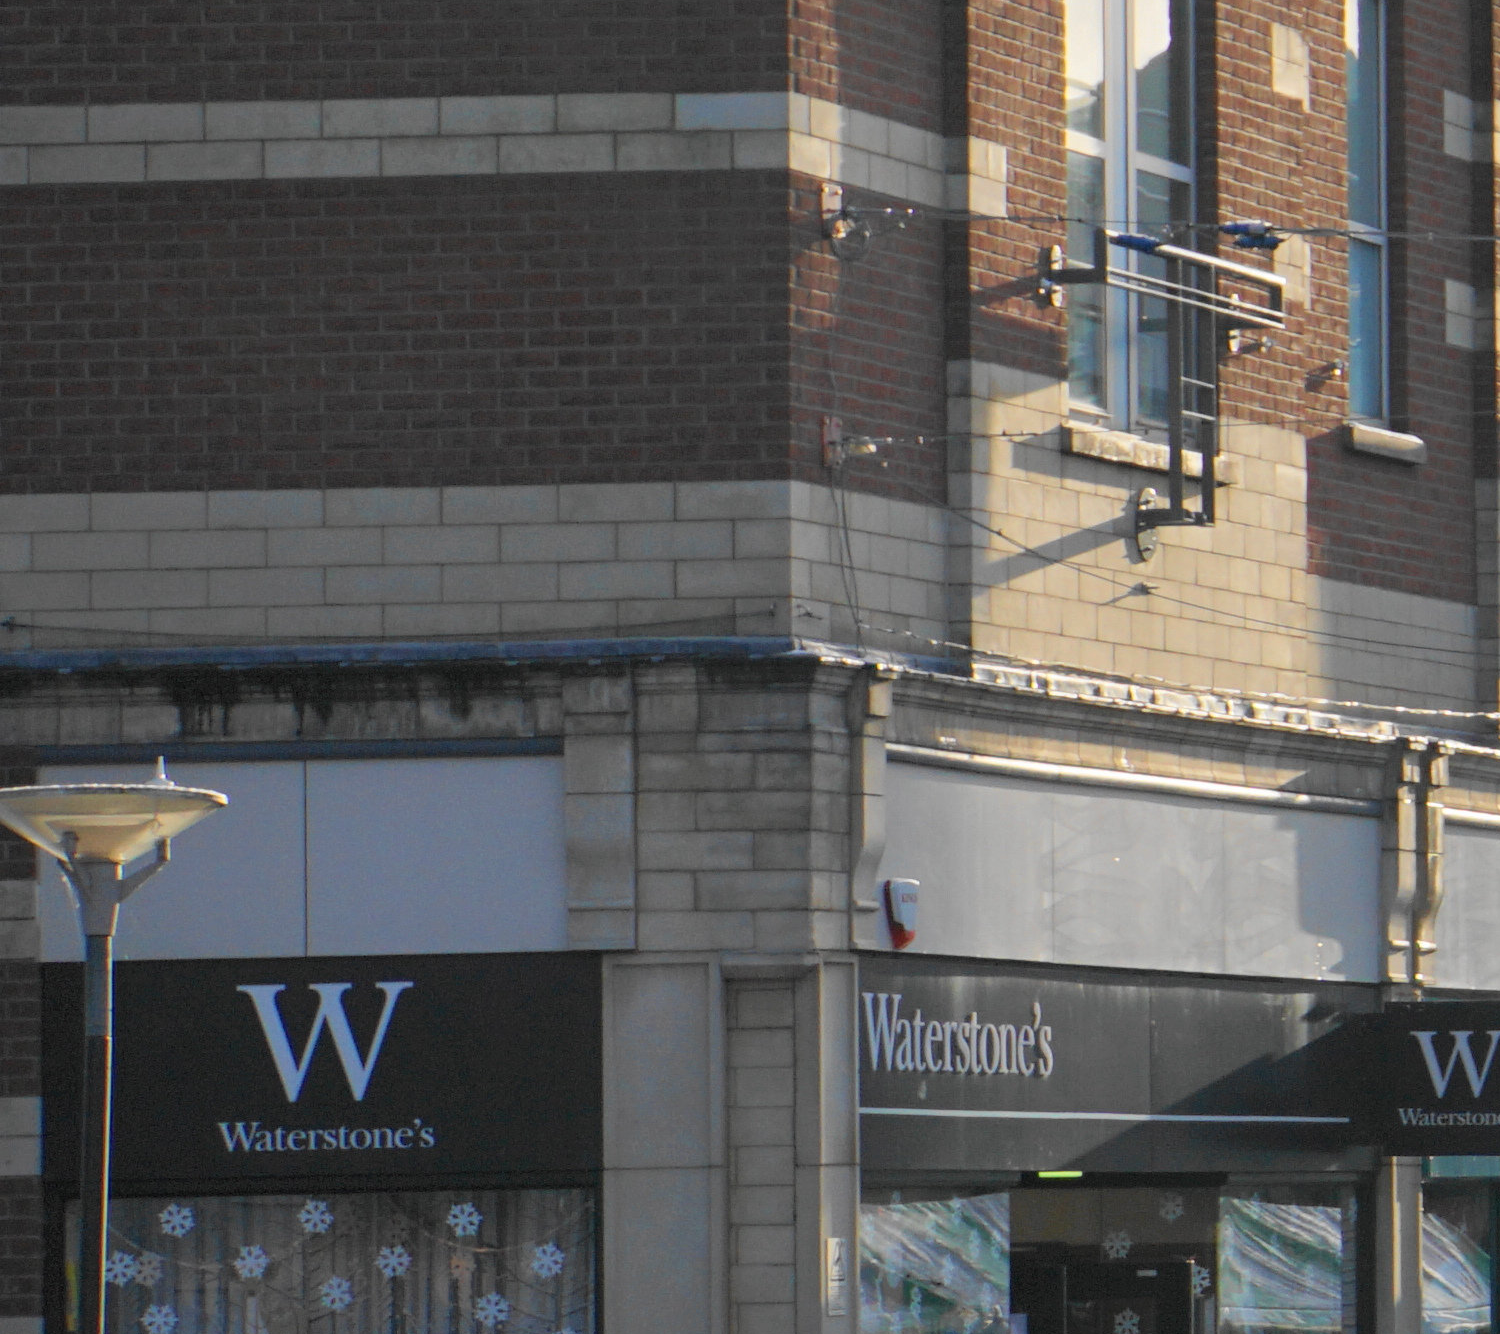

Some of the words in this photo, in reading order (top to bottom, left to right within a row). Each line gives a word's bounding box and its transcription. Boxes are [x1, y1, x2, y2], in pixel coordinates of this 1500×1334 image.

[236, 981, 414, 1102] W
[862, 992, 1054, 1078] Waterstone's
[218, 1118, 435, 1153] Waterstone's
